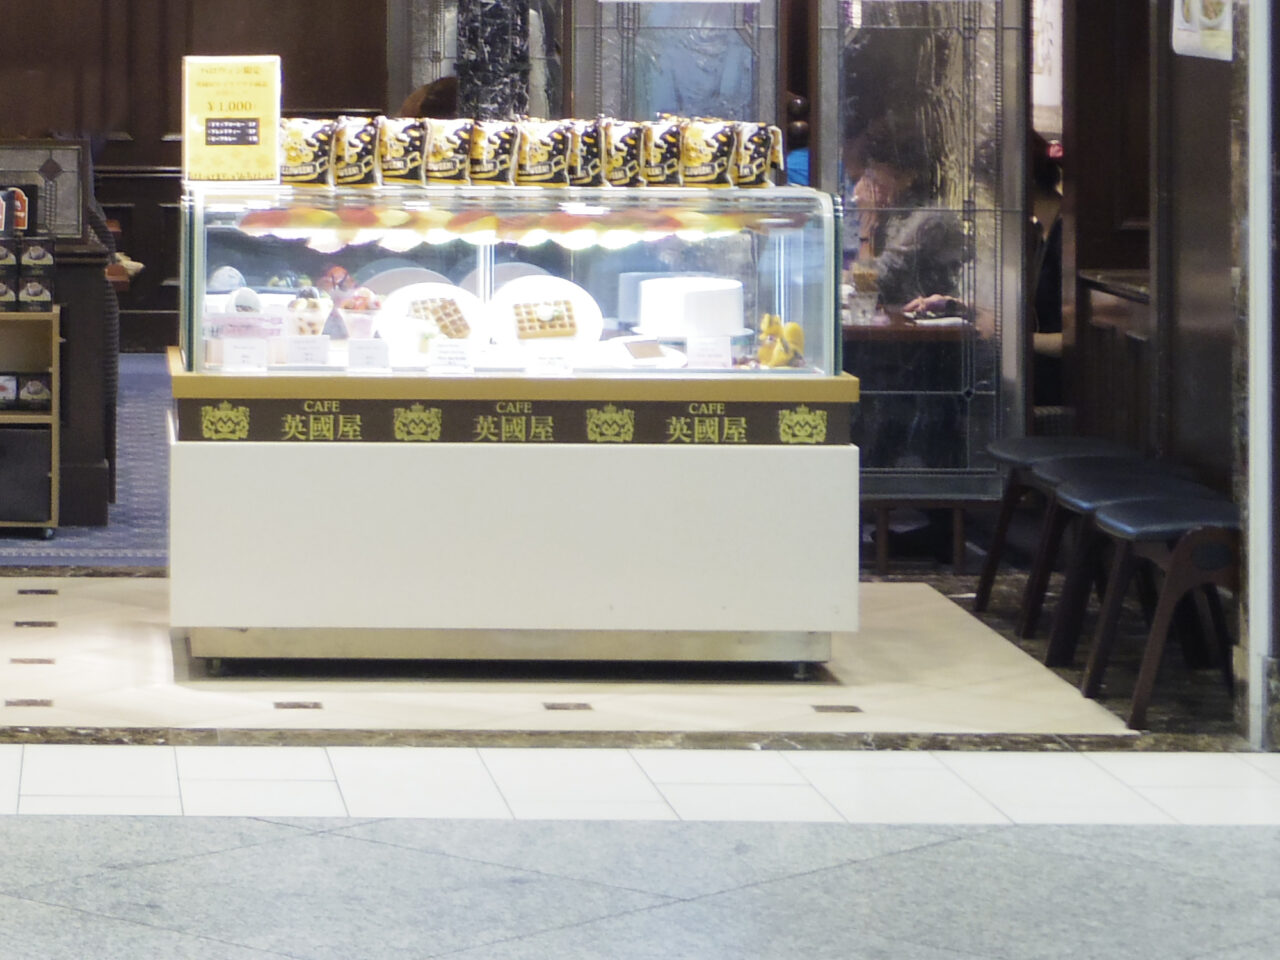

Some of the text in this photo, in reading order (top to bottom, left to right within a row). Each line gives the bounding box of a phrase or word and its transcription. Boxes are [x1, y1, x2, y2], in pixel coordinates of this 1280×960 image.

[303, 400, 340, 413] CAFE
[496, 401, 532, 414] CAFE
[688, 402, 725, 415] CAFE
[280, 414, 363, 441] 英國屋
[473, 415, 555, 442] 英國屋
[665, 416, 748, 443] 英國屋
